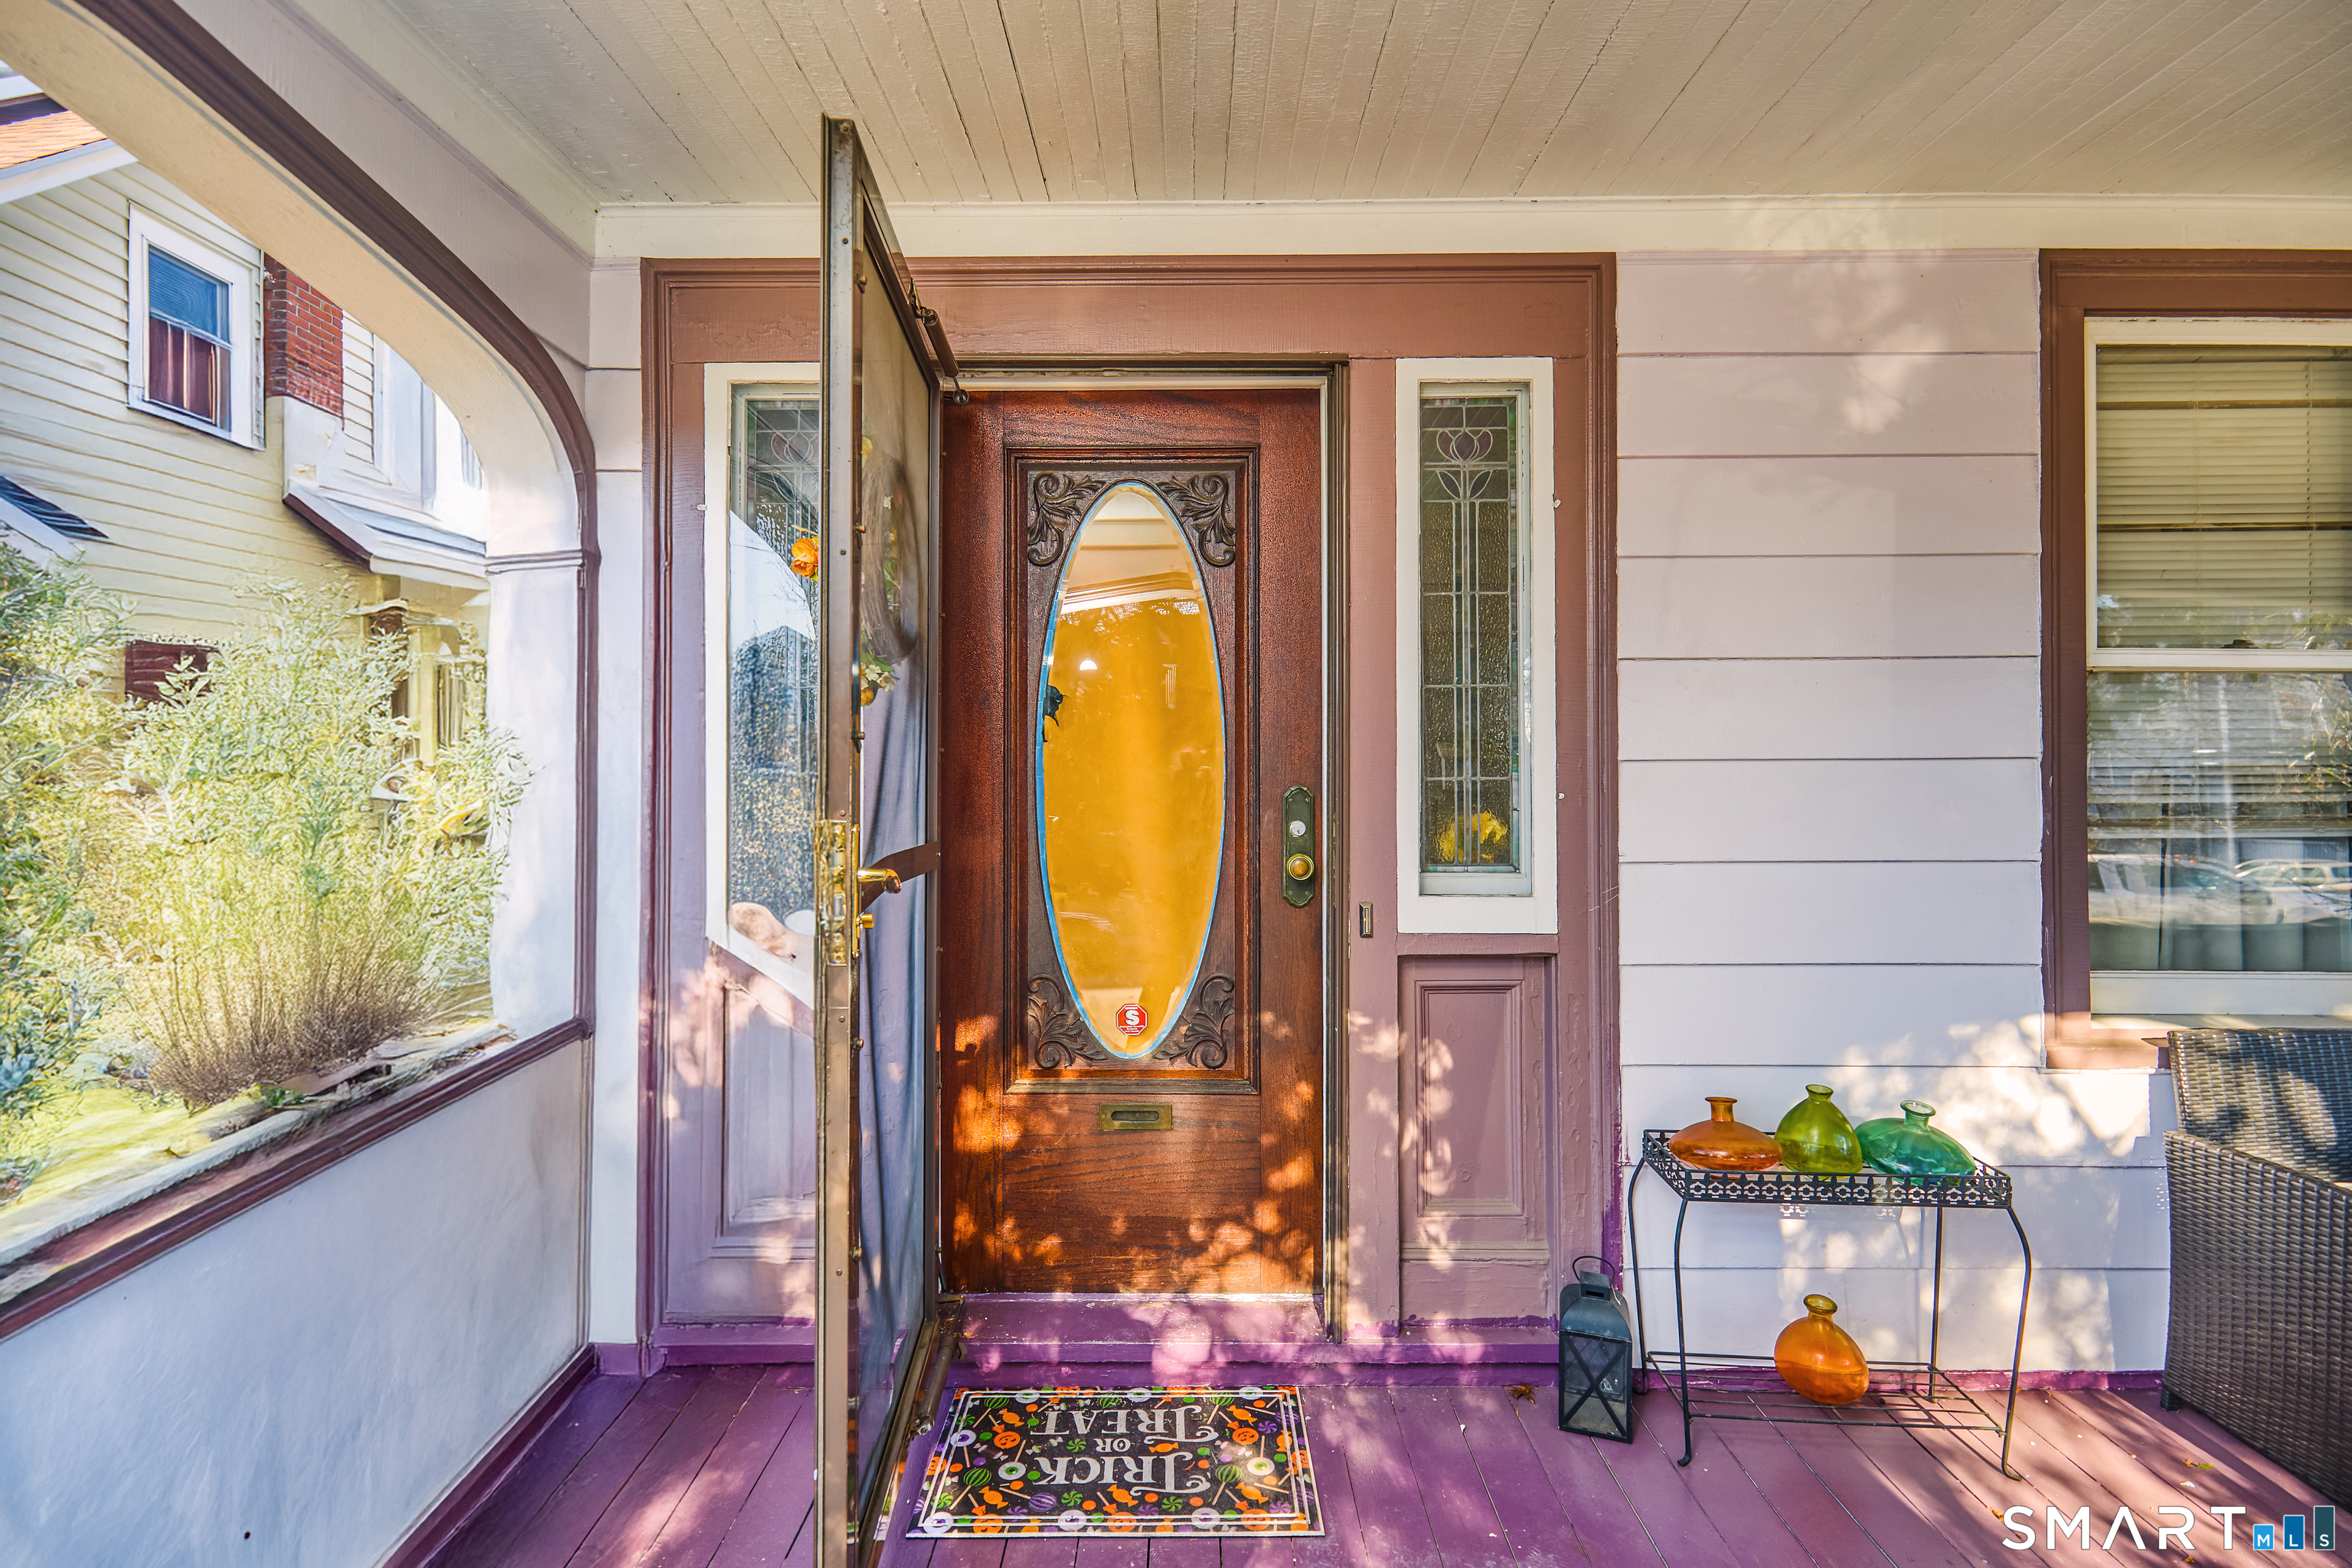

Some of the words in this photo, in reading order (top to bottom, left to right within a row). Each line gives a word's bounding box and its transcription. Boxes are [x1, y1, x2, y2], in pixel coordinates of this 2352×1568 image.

[1124, 1009, 1140, 1026] S
[1030, 1405, 1219, 1443] TREAT
[1094, 1438, 1131, 1452] OR
[1034, 1452, 1210, 1496] TRICK
